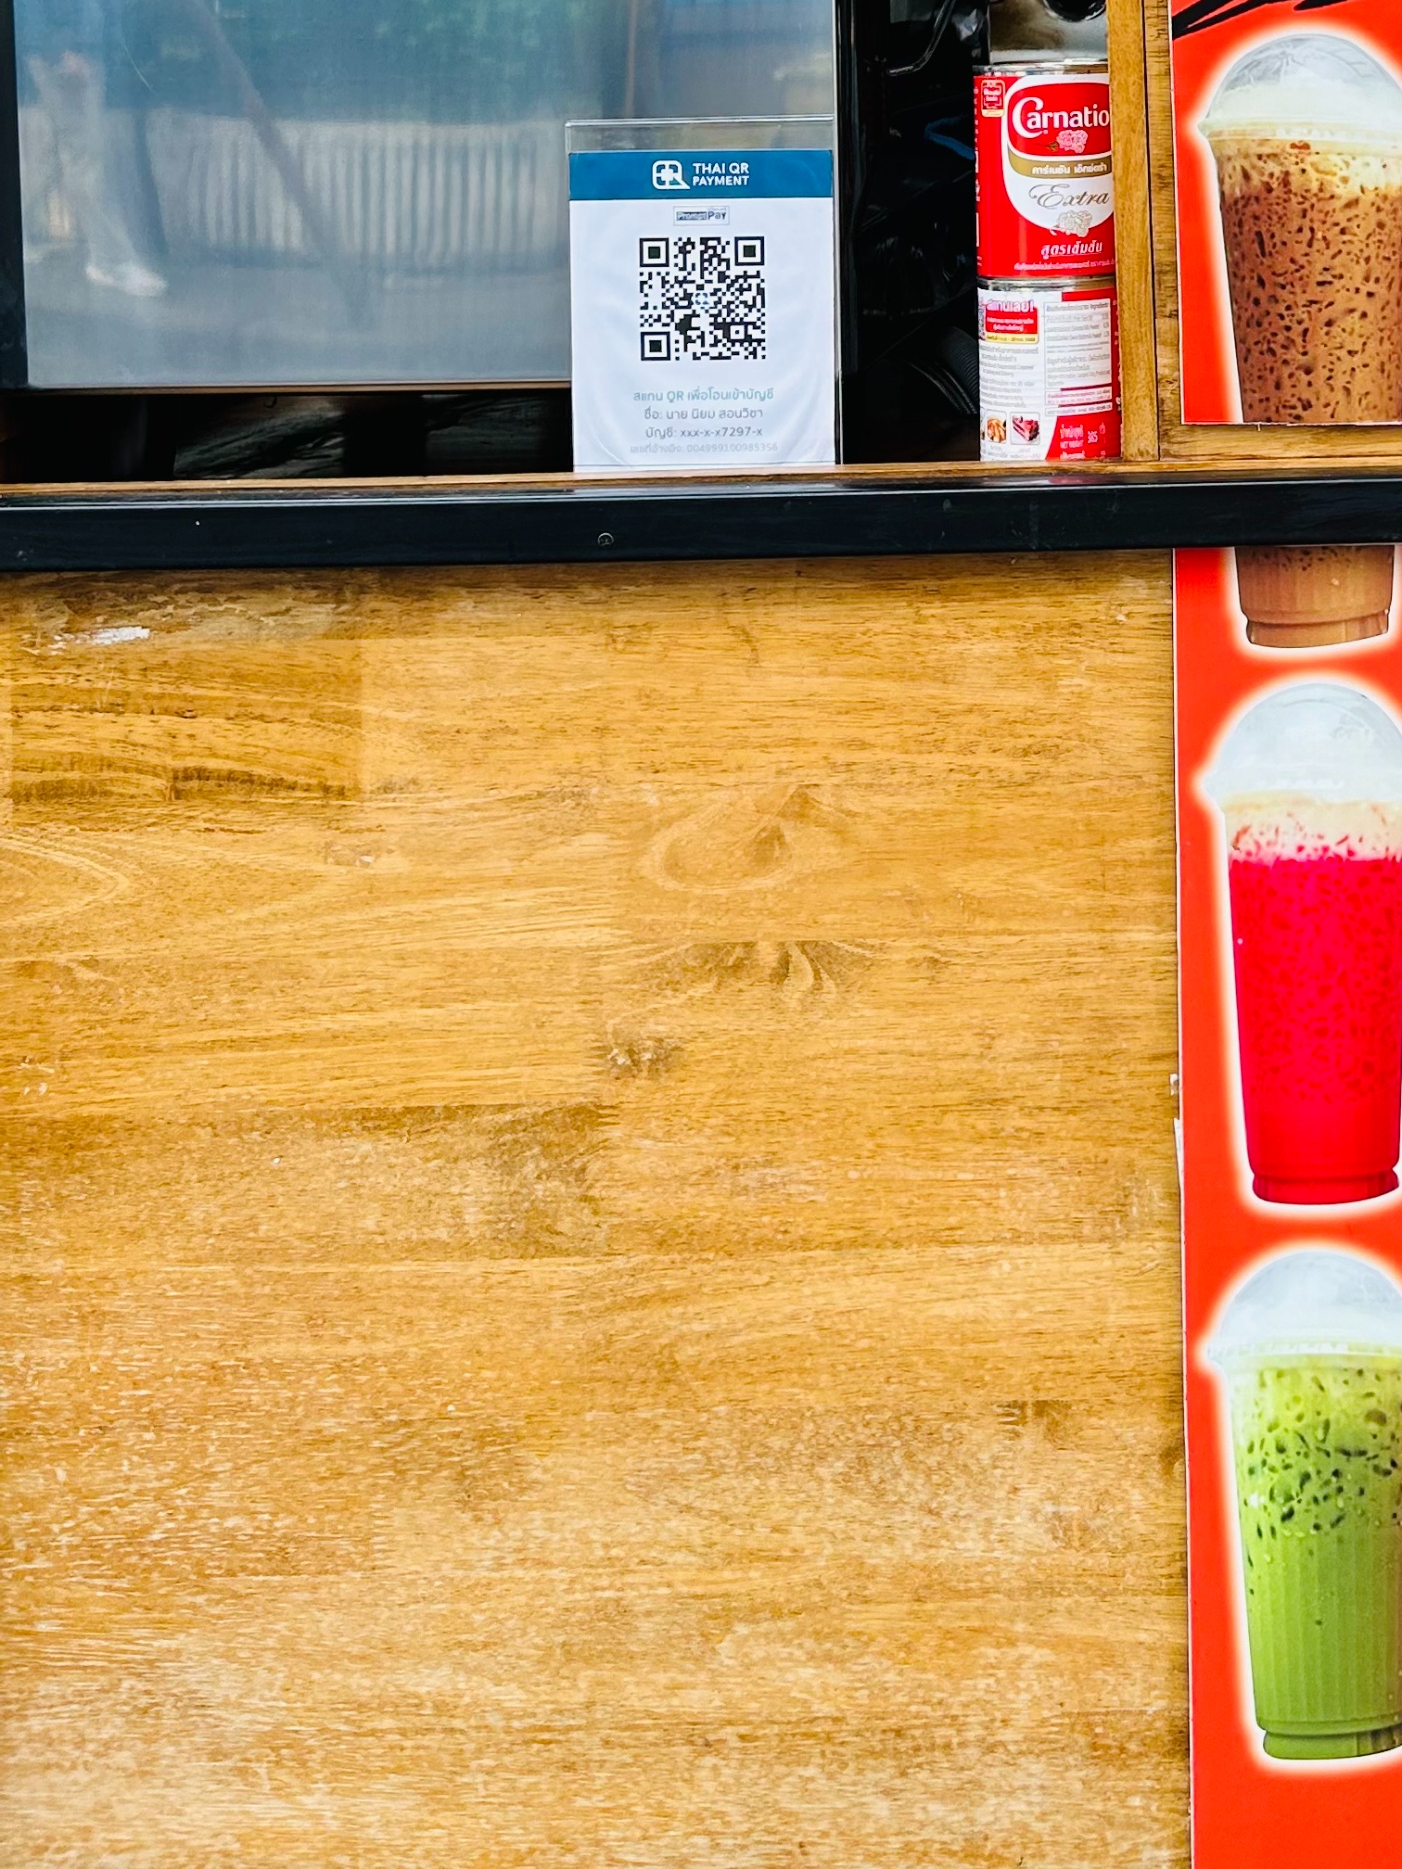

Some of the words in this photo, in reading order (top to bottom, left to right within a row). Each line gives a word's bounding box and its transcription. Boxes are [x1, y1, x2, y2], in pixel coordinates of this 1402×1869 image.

[1012, 96, 1110, 139] Carnatio
[692, 162, 726, 174] THAI
[728, 162, 750, 174] QR
[692, 176, 750, 186] PAYMENT
[1028, 183, 1110, 210] Extra
[633, 391, 663, 402] สแกน
[666, 390, 685, 403] QR
